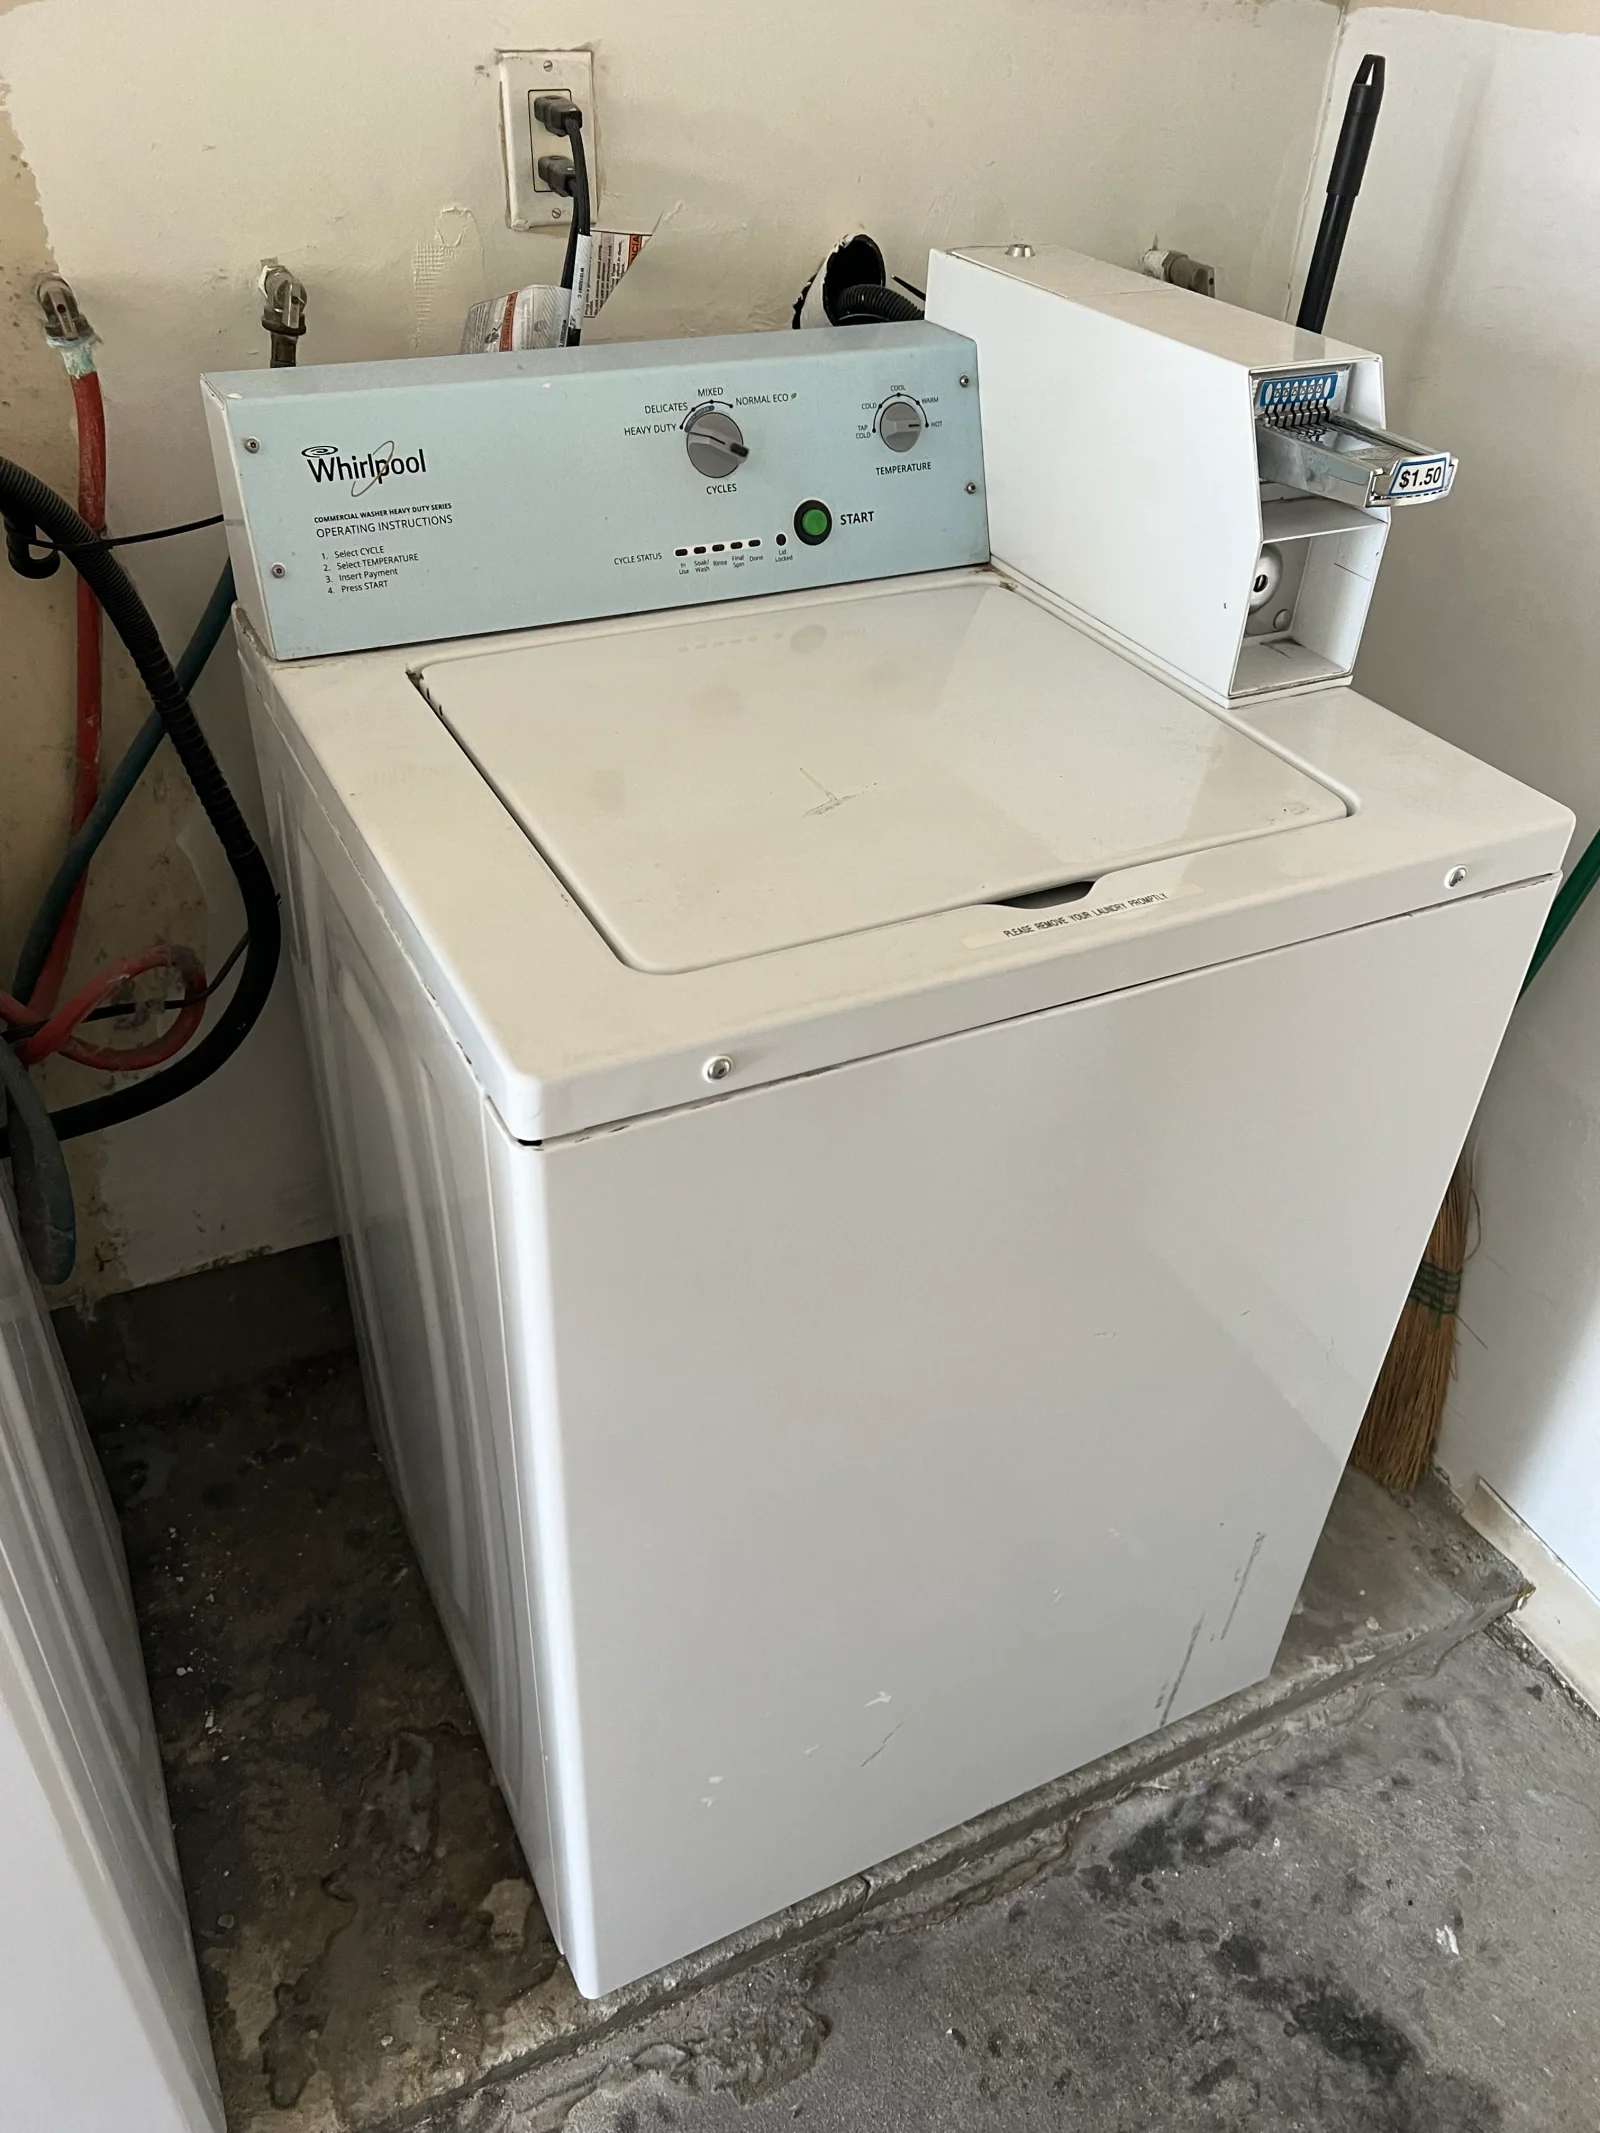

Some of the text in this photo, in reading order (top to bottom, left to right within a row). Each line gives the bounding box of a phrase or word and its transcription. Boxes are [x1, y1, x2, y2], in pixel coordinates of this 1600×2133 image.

[697, 387, 724, 397] MIXED
[735, 393, 789, 406] NORMAL ECO
[861, 402, 877, 410] COLD
[644, 402, 688, 414] DELICATES
[624, 423, 677, 436] HEAVY DUTY
[307, 449, 426, 484] Whirlpool
[876, 462, 932, 476] TEMPERATURE
[1399, 466, 1442, 490] $1.50
[706, 483, 737, 495] CYCLES
[314, 513, 359, 523] COMMERCIAL
[360, 509, 388, 518] WASHER
[389, 507, 410, 515] HEAVY
[412, 505, 430, 513] DUTY
[840, 511, 875, 525] START
[316, 514, 453, 538] OPERATING INSTRUCTIONS
[334, 549, 358, 558] Select
[360, 546, 384, 556] CYCLE
[613, 552, 663, 565] CYCLE STATUS
[749, 554, 764, 562] Done
[323, 553, 419, 572] 2. Select TEMPERATURE
[733, 561, 745, 569] Spin
[775, 555, 793, 563] Locked
[325, 568, 398, 583] 3. Insert Payment
[695, 565, 710, 573] Wash
[341, 585, 362, 593] Press
[364, 580, 388, 590] START
[1003, 893, 1168, 938] PLEASE REMOVE YOUR LAUNDRY PROMPTLY
